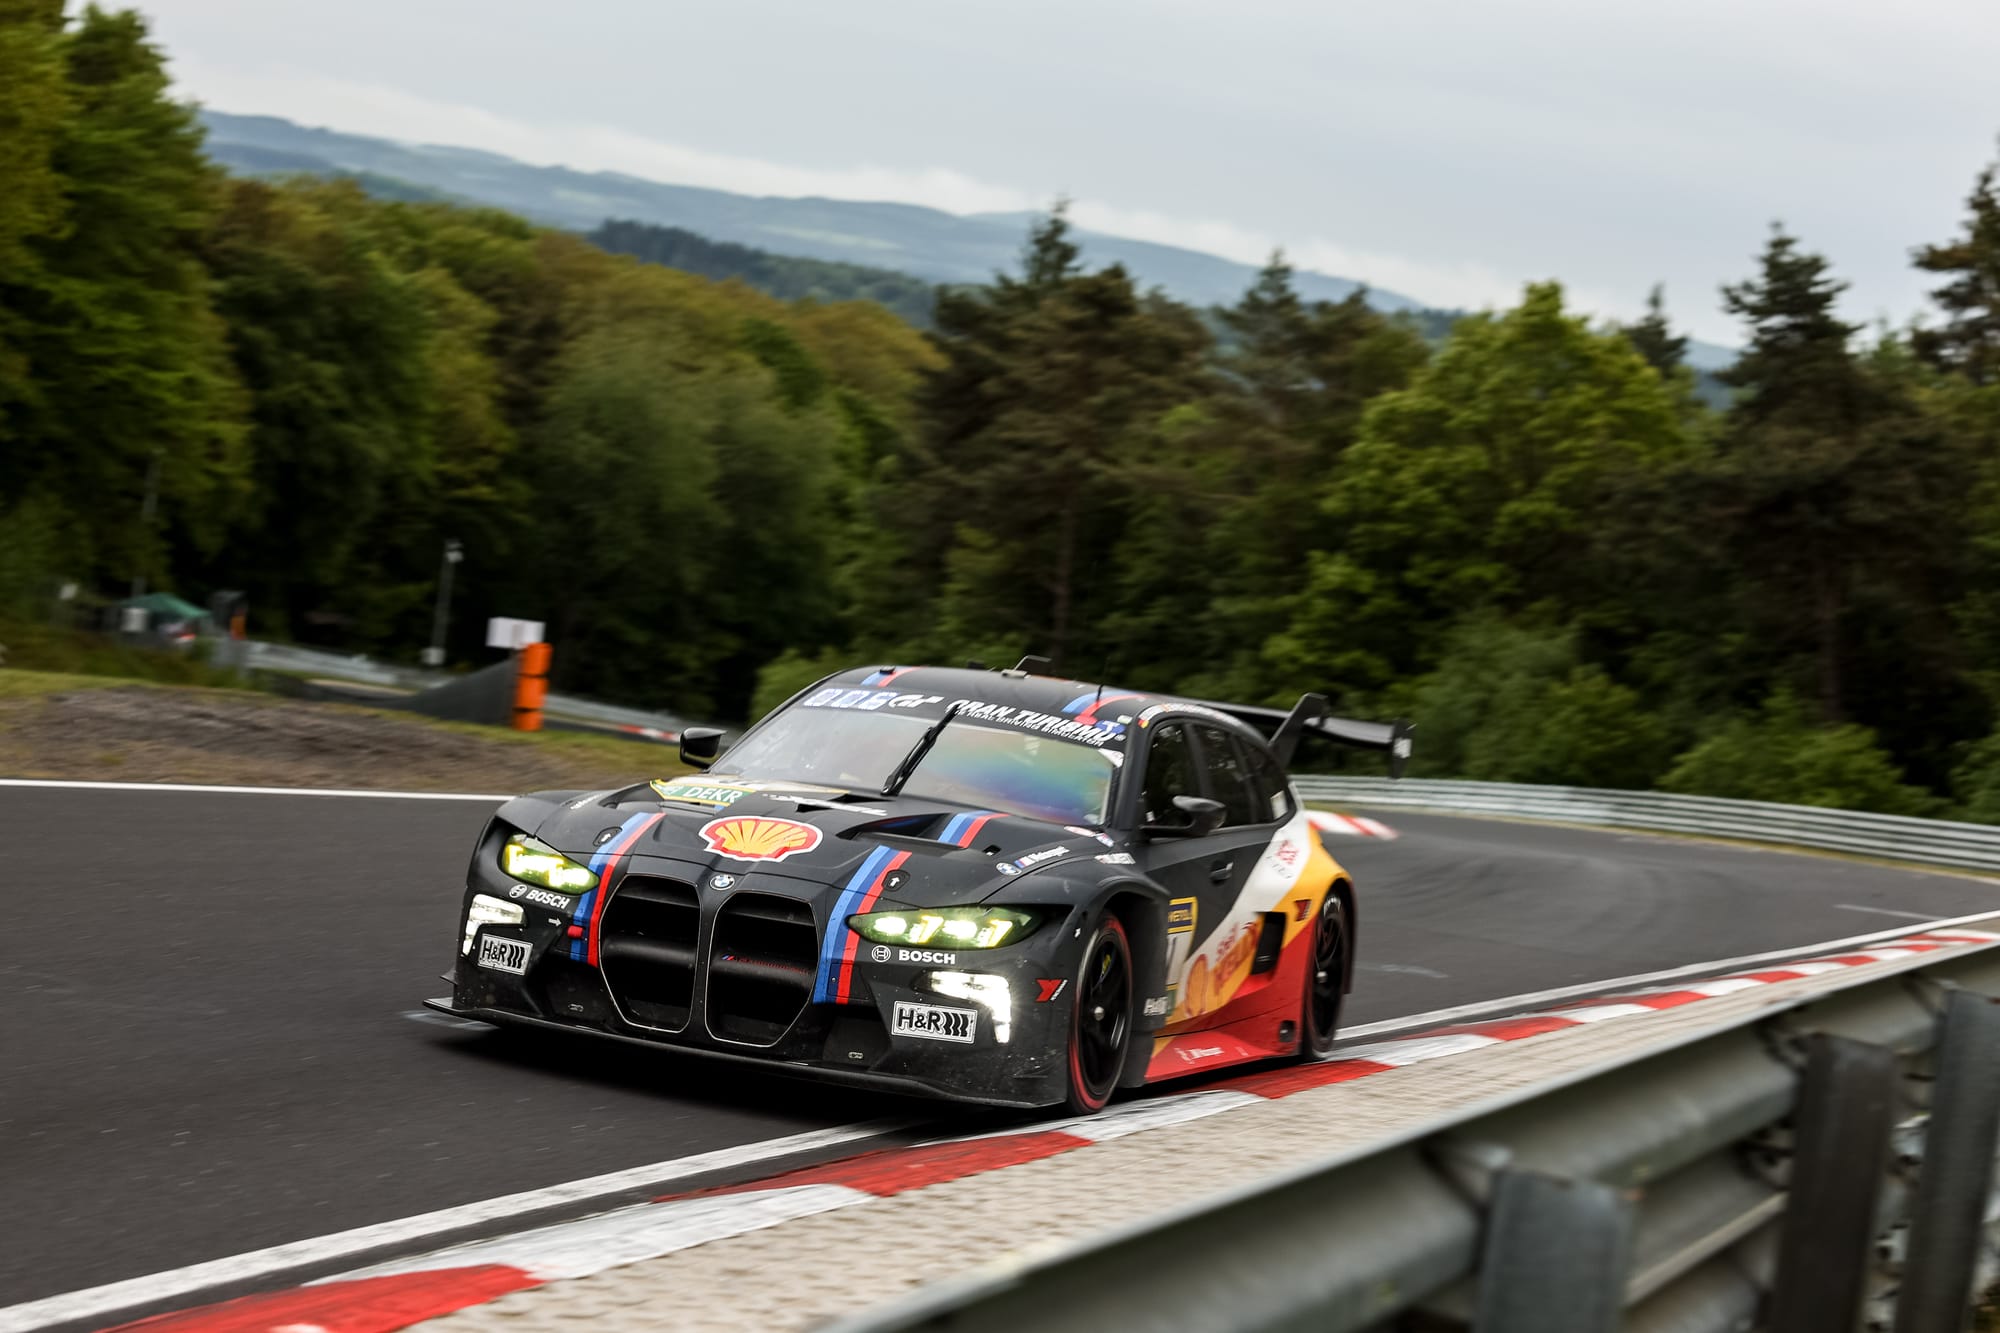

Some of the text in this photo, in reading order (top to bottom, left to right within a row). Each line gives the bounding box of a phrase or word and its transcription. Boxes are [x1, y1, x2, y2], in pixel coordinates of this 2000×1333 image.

[683, 786, 743, 803] DEKR
[526, 889, 570, 909] BOSCH
[899, 949, 955, 965] BOSCH
